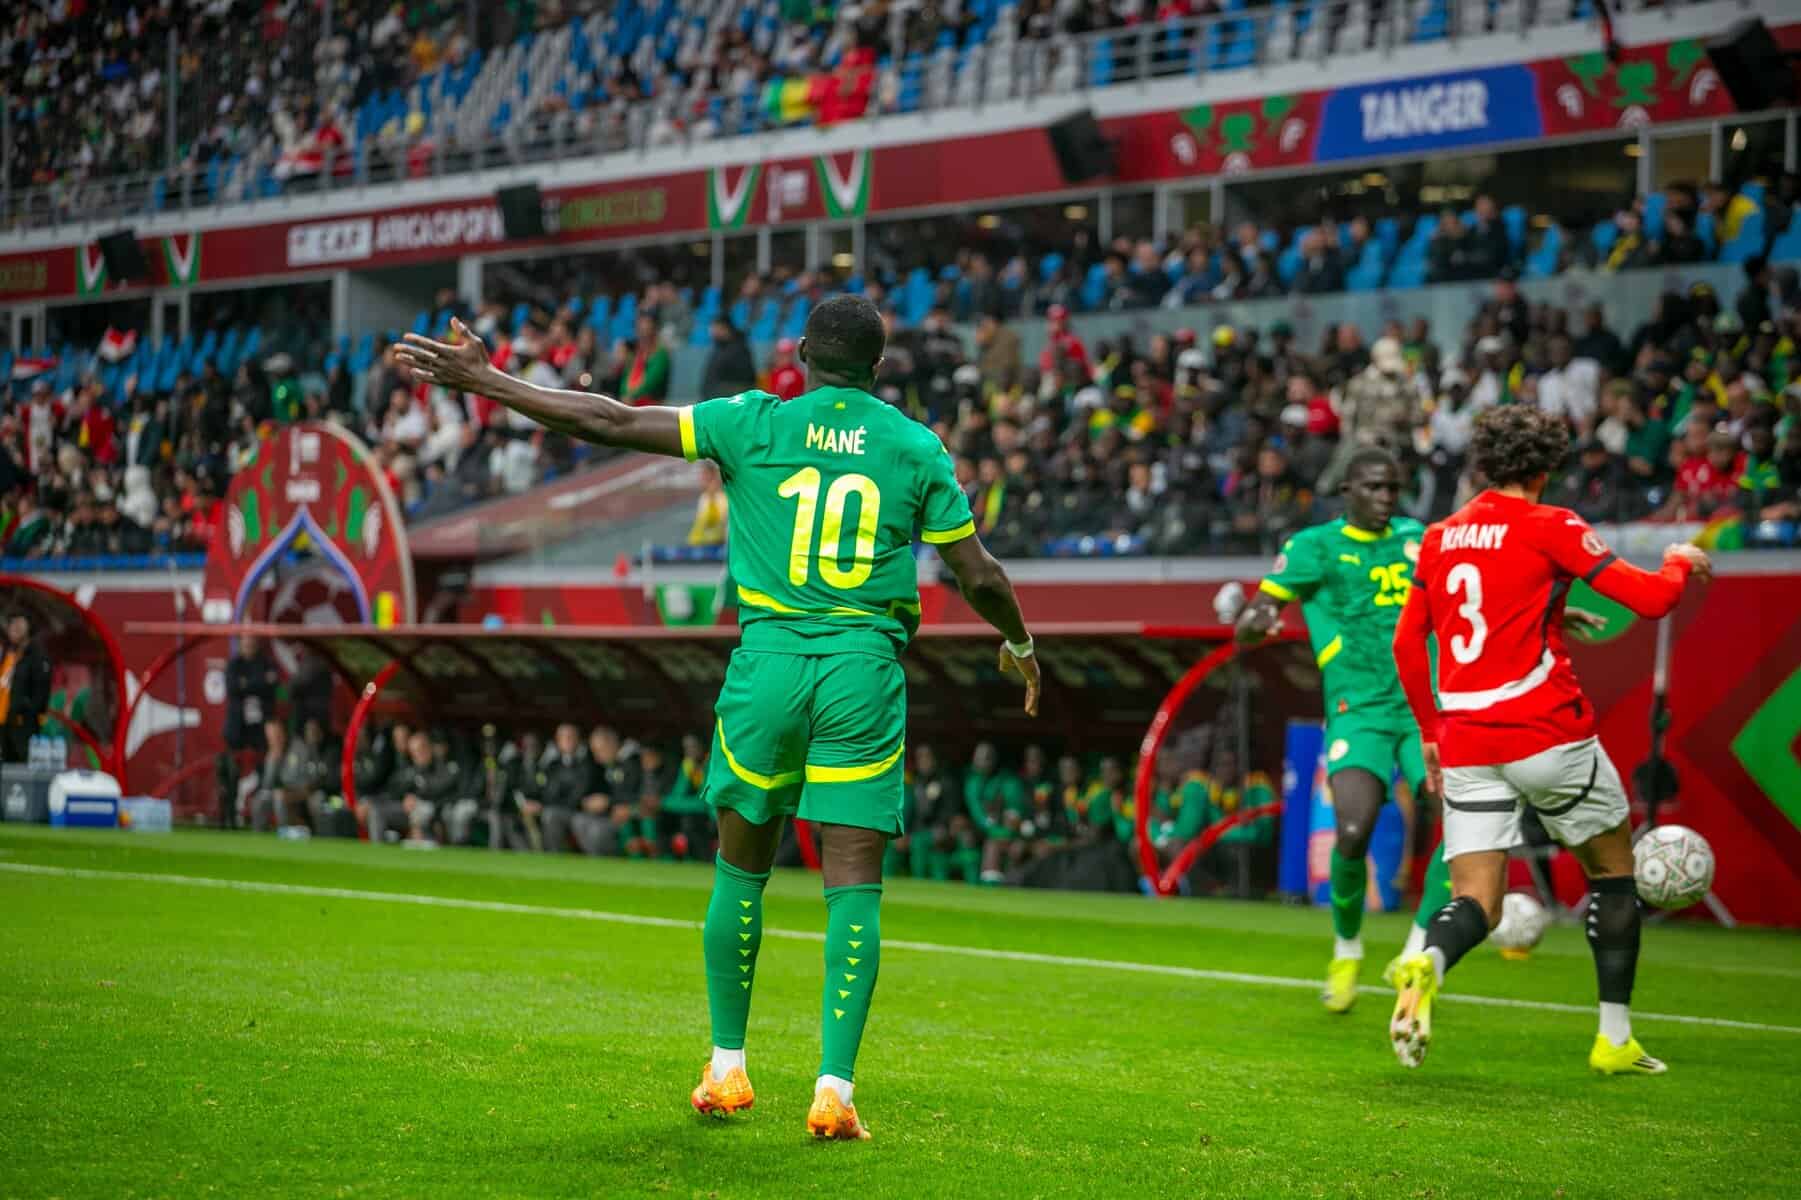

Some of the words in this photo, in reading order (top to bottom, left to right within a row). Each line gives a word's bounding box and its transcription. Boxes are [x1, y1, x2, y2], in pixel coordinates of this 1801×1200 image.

[1361, 80, 1488, 142] TANGER
[806, 422, 867, 455] MANÉ
[778, 466, 881, 590] 10
[1369, 563, 1412, 607] 25
[1446, 562, 1488, 664] 3
